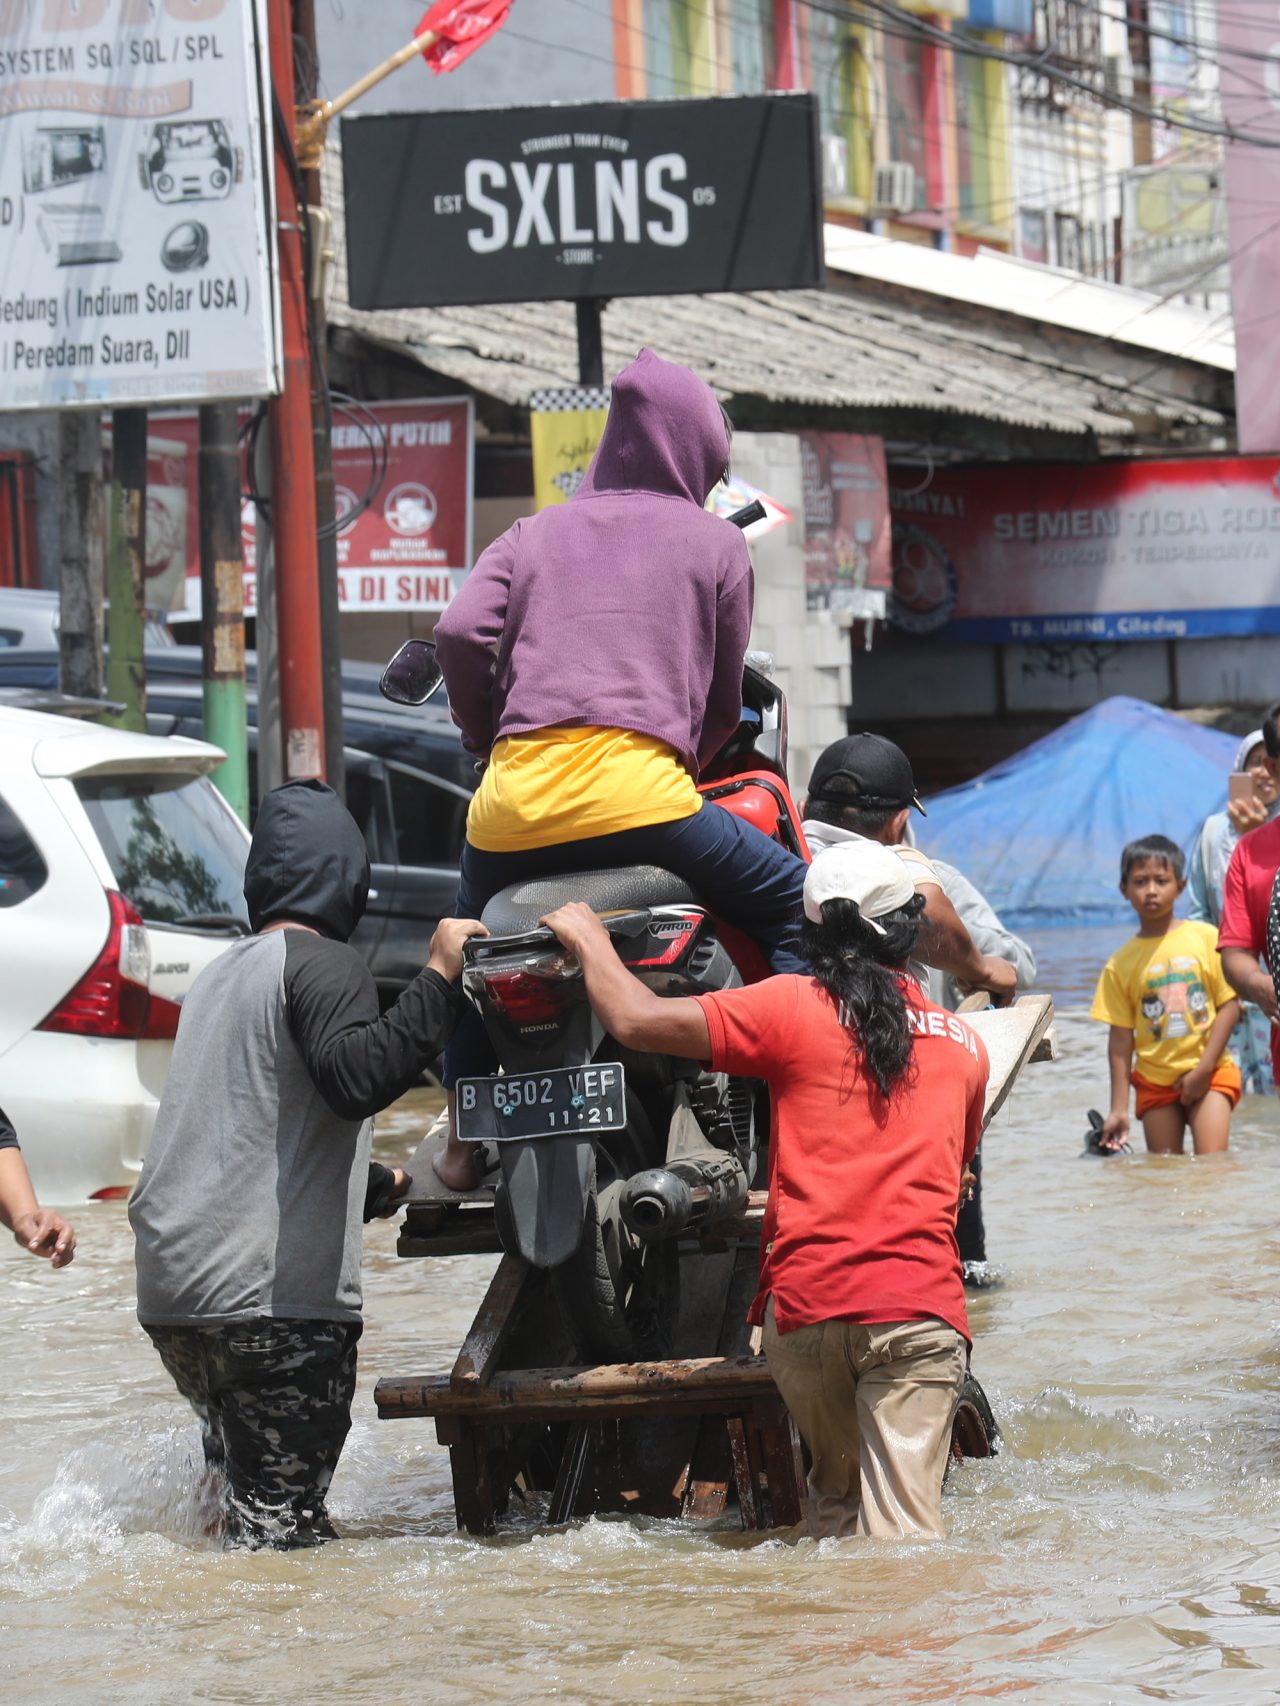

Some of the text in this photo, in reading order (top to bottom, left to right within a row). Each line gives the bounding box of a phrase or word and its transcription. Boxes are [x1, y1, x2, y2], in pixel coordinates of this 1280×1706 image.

[87, 43, 112, 69] SQ
[130, 38, 166, 65] SQL
[185, 34, 224, 61] SPL
[434, 195, 463, 215] EST
[465, 153, 690, 254] SXLNS
[76, 285, 138, 318] Indium
[145, 281, 193, 313] Solar
[201, 278, 238, 309] USA
[13, 339, 94, 370] Peredam
[101, 334, 159, 368] Suara,
[391, 420, 452, 446] PUTIH
[993, 509, 1121, 542] SEMEN
[1130, 507, 1208, 537] TIGA
[360, 576, 386, 602] DI
[397, 575, 450, 602] SINI
[1116, 616, 1187, 637] Ciledug
[647, 920, 693, 936] VARIO
[520, 1022, 559, 1034] HONDA
[838, 999, 978, 1061] INNESIA
[462, 1069, 616, 1110] B 6502 VEF
